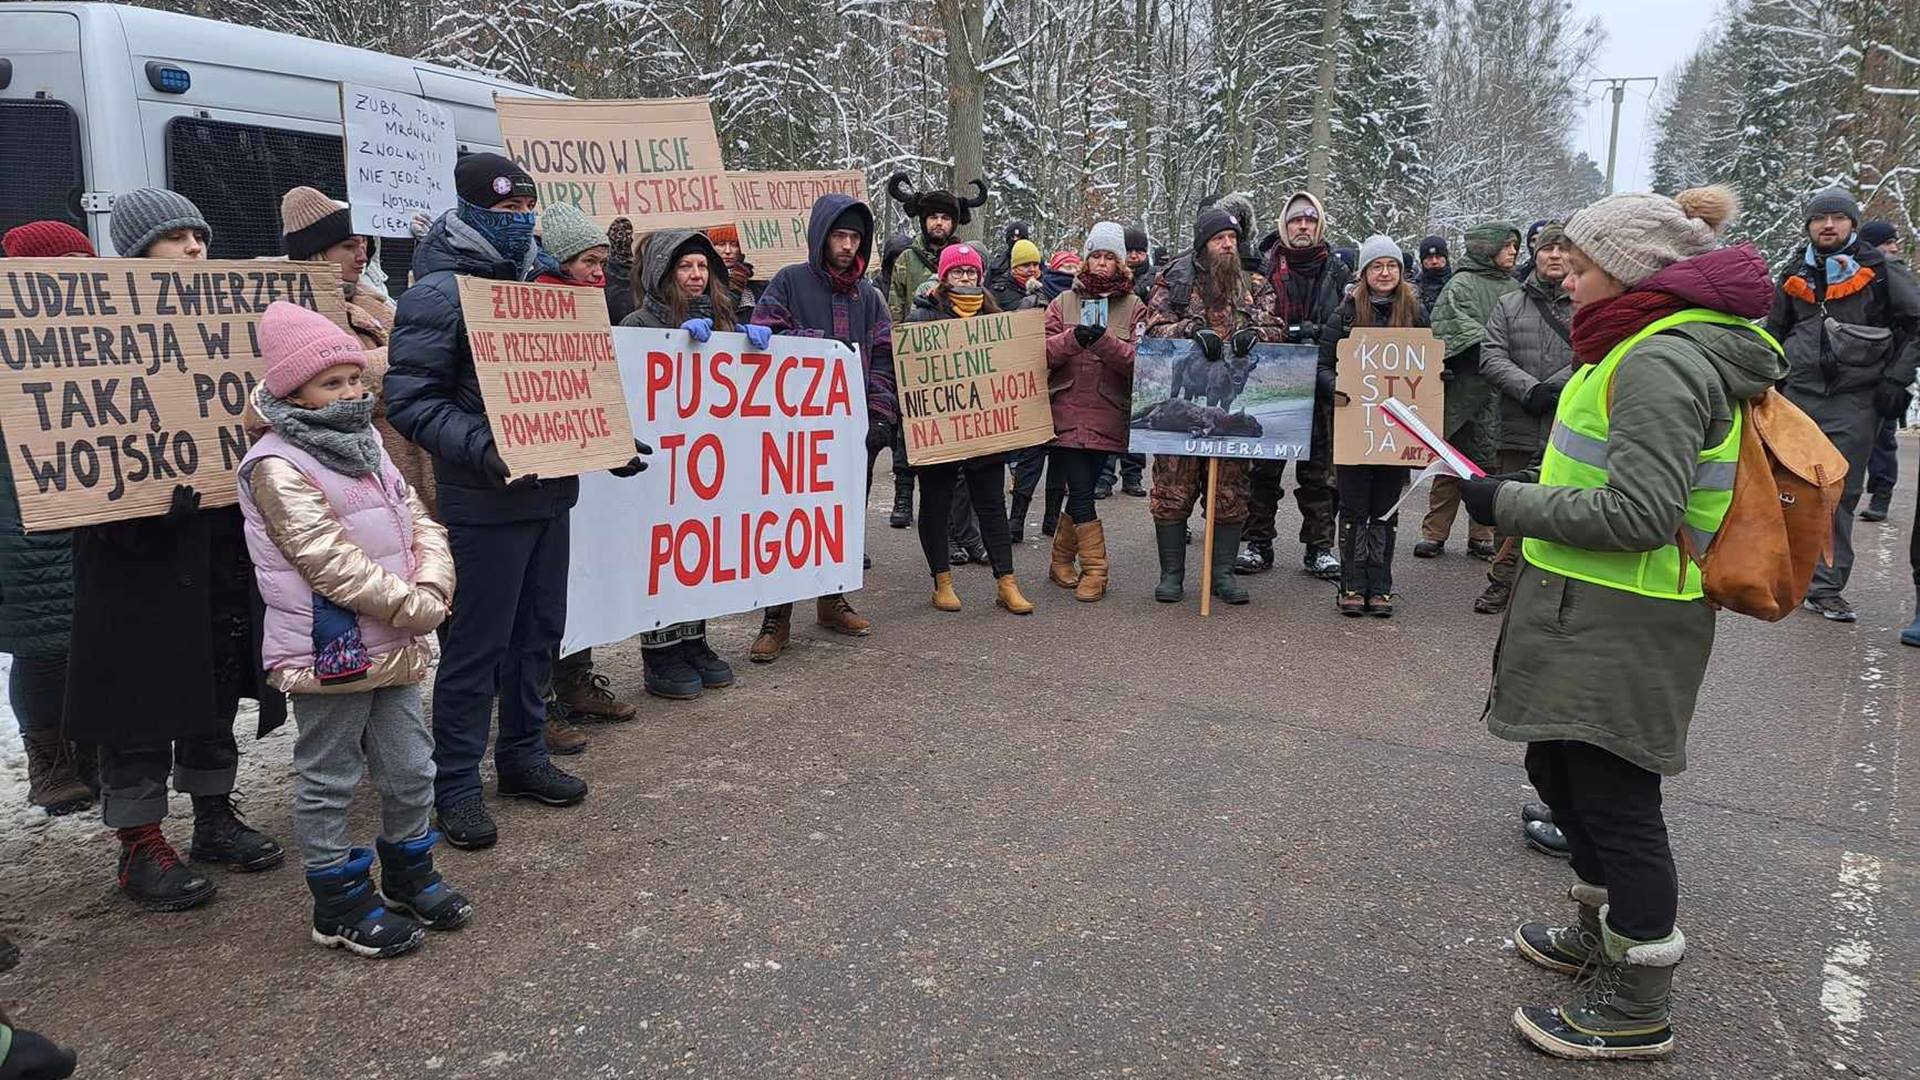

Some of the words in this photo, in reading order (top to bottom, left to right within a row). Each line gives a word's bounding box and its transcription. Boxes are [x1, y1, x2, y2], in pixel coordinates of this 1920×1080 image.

[505, 138, 606, 174] WOJSKO
[609, 139, 629, 174] W
[634, 136, 695, 173] LESIE
[358, 166, 385, 184] NIE
[731, 180, 763, 211] NIE
[743, 217, 784, 249] NAM
[125, 271, 141, 316] I
[965, 314, 1014, 346] WILKI
[0, 322, 189, 376] UMIERAJĄ
[196, 322, 231, 360] W
[471, 331, 501, 363] NIE
[503, 331, 615, 371] PRZESZKADZAJCIE
[1361, 343, 1426, 371] KON
[503, 368, 593, 405] LUDZIOM
[646, 351, 852, 422] PUSZCZA
[899, 359, 907, 387] I
[990, 370, 1038, 404] WOJA
[1360, 374, 1424, 401] STY
[21, 376, 162, 433] TAKĄ
[193, 371, 259, 418] PO
[500, 407, 612, 450] POMAGAJCIE
[911, 419, 944, 449] NA
[949, 405, 1020, 441] TERENIE
[1362, 430, 1396, 456] JA
[20, 429, 199, 501] WOJSKO
[1184, 439, 1265, 456] UMIERA
[1274, 444, 1303, 458] MY
[659, 432, 726, 506] TO
[761, 429, 835, 496] NIE
[647, 504, 845, 597] POLIGON
